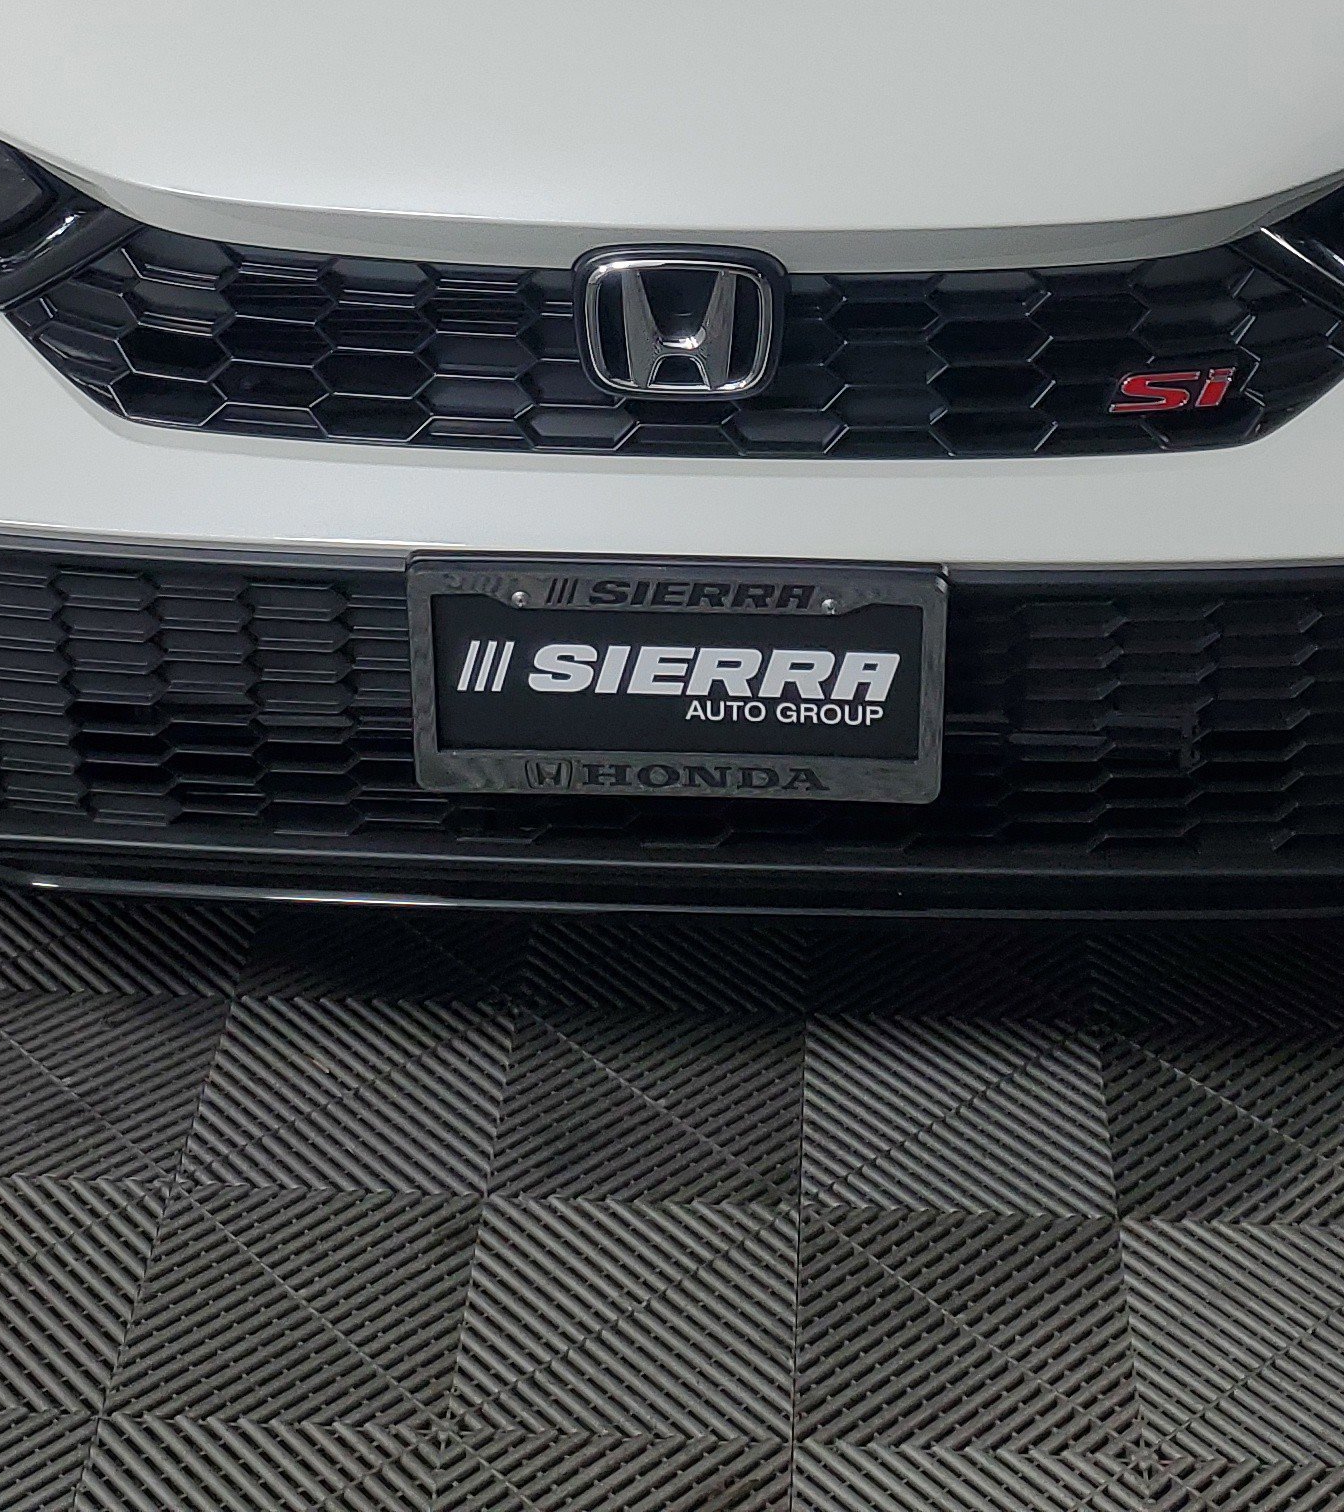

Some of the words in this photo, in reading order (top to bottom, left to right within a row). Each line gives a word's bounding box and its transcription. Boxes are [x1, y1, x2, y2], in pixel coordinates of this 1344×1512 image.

[1109, 367, 1236, 412] Si
[589, 579, 816, 610] SIERRA
[527, 643, 901, 701] SIERRA
[685, 699, 767, 722] AUTO
[775, 701, 884, 726] GROUP
[582, 762, 830, 791] HONDA
